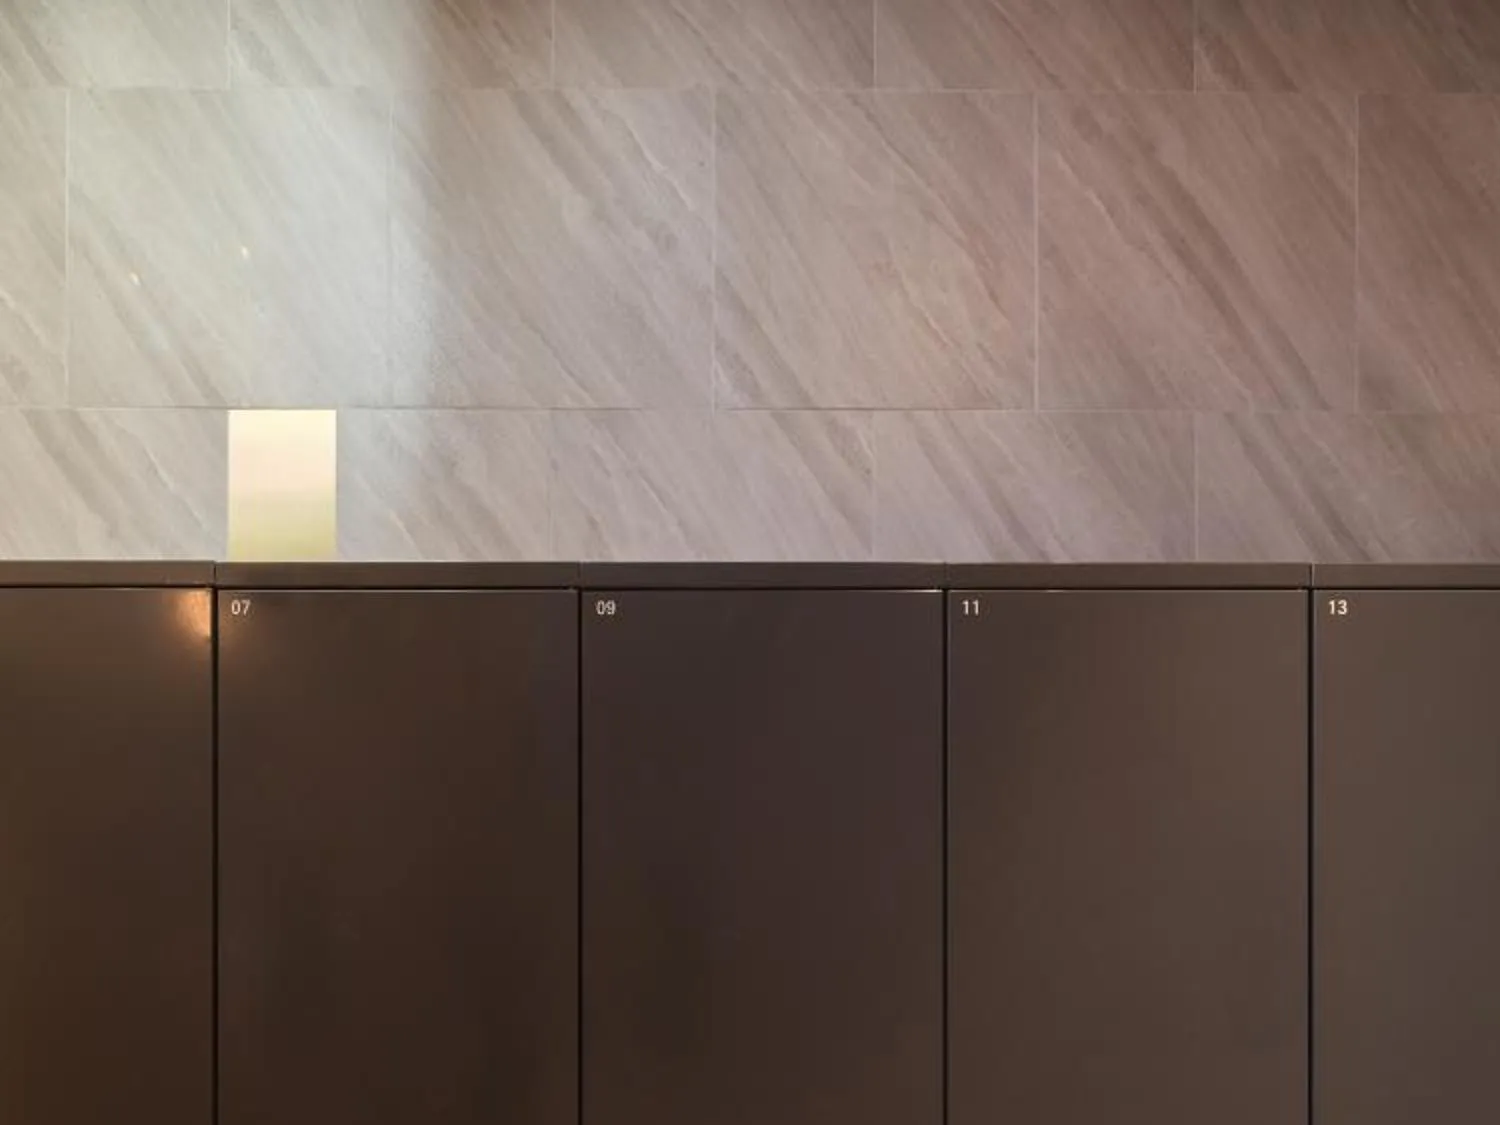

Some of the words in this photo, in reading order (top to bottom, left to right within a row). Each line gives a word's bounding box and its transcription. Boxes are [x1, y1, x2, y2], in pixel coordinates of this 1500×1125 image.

[231, 599, 251, 615] 07
[596, 600, 616, 615] 09
[962, 599, 980, 615] 11
[1328, 599, 1348, 615] 13
